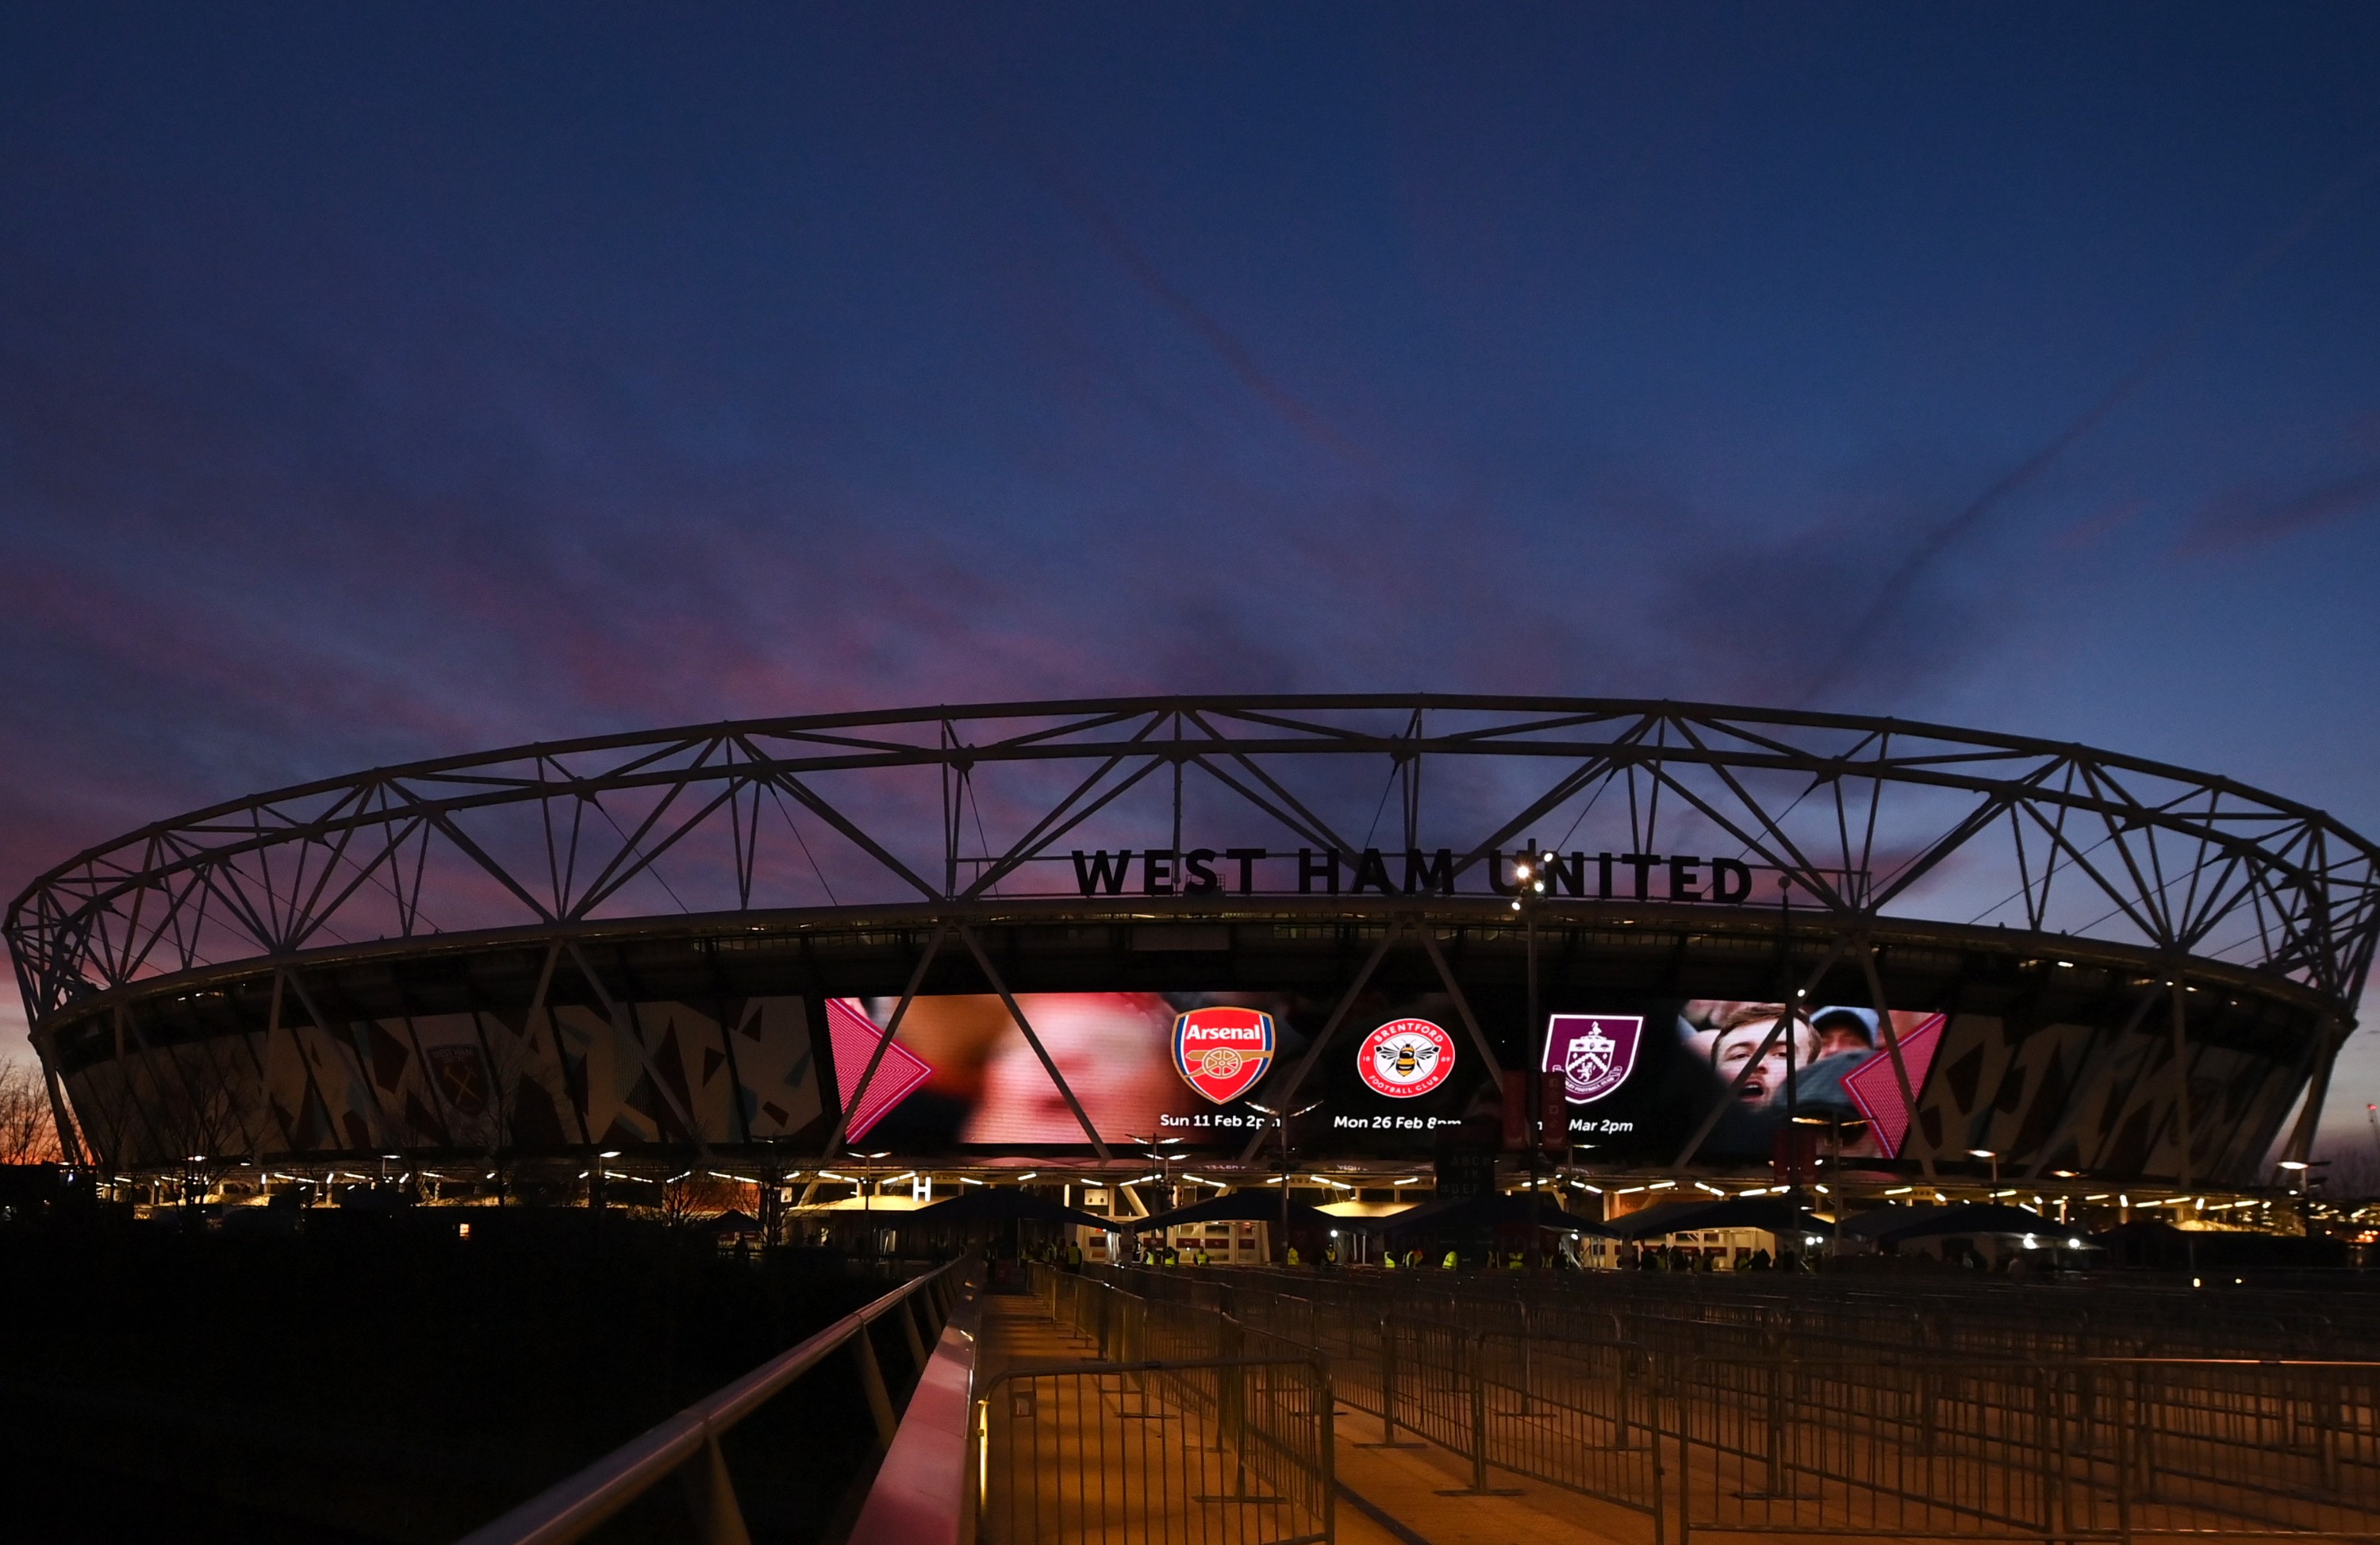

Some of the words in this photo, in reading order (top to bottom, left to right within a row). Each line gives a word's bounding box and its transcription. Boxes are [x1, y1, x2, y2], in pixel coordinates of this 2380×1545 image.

[1071, 847, 1266, 896] WEST
[1298, 847, 1454, 895] HAM
[1185, 1024, 1261, 1040] Arsenal
[1373, 1022, 1444, 1043] BRENTFORD
[1368, 1074, 1413, 1094] FOOTBALL
[1415, 1075, 1439, 1091] CLUB
[1160, 1114, 1190, 1127] Sun
[1193, 1115, 1211, 1127] 11
[1215, 1115, 1243, 1127] Feb
[1334, 1116, 1368, 1128] Mon
[1372, 1116, 1392, 1128] 26
[1395, 1116, 1424, 1129] Feb
[1568, 1118, 1598, 1132] Mar
[1600, 1119, 1633, 1135] 2pm
[912, 1176, 931, 1202] H
